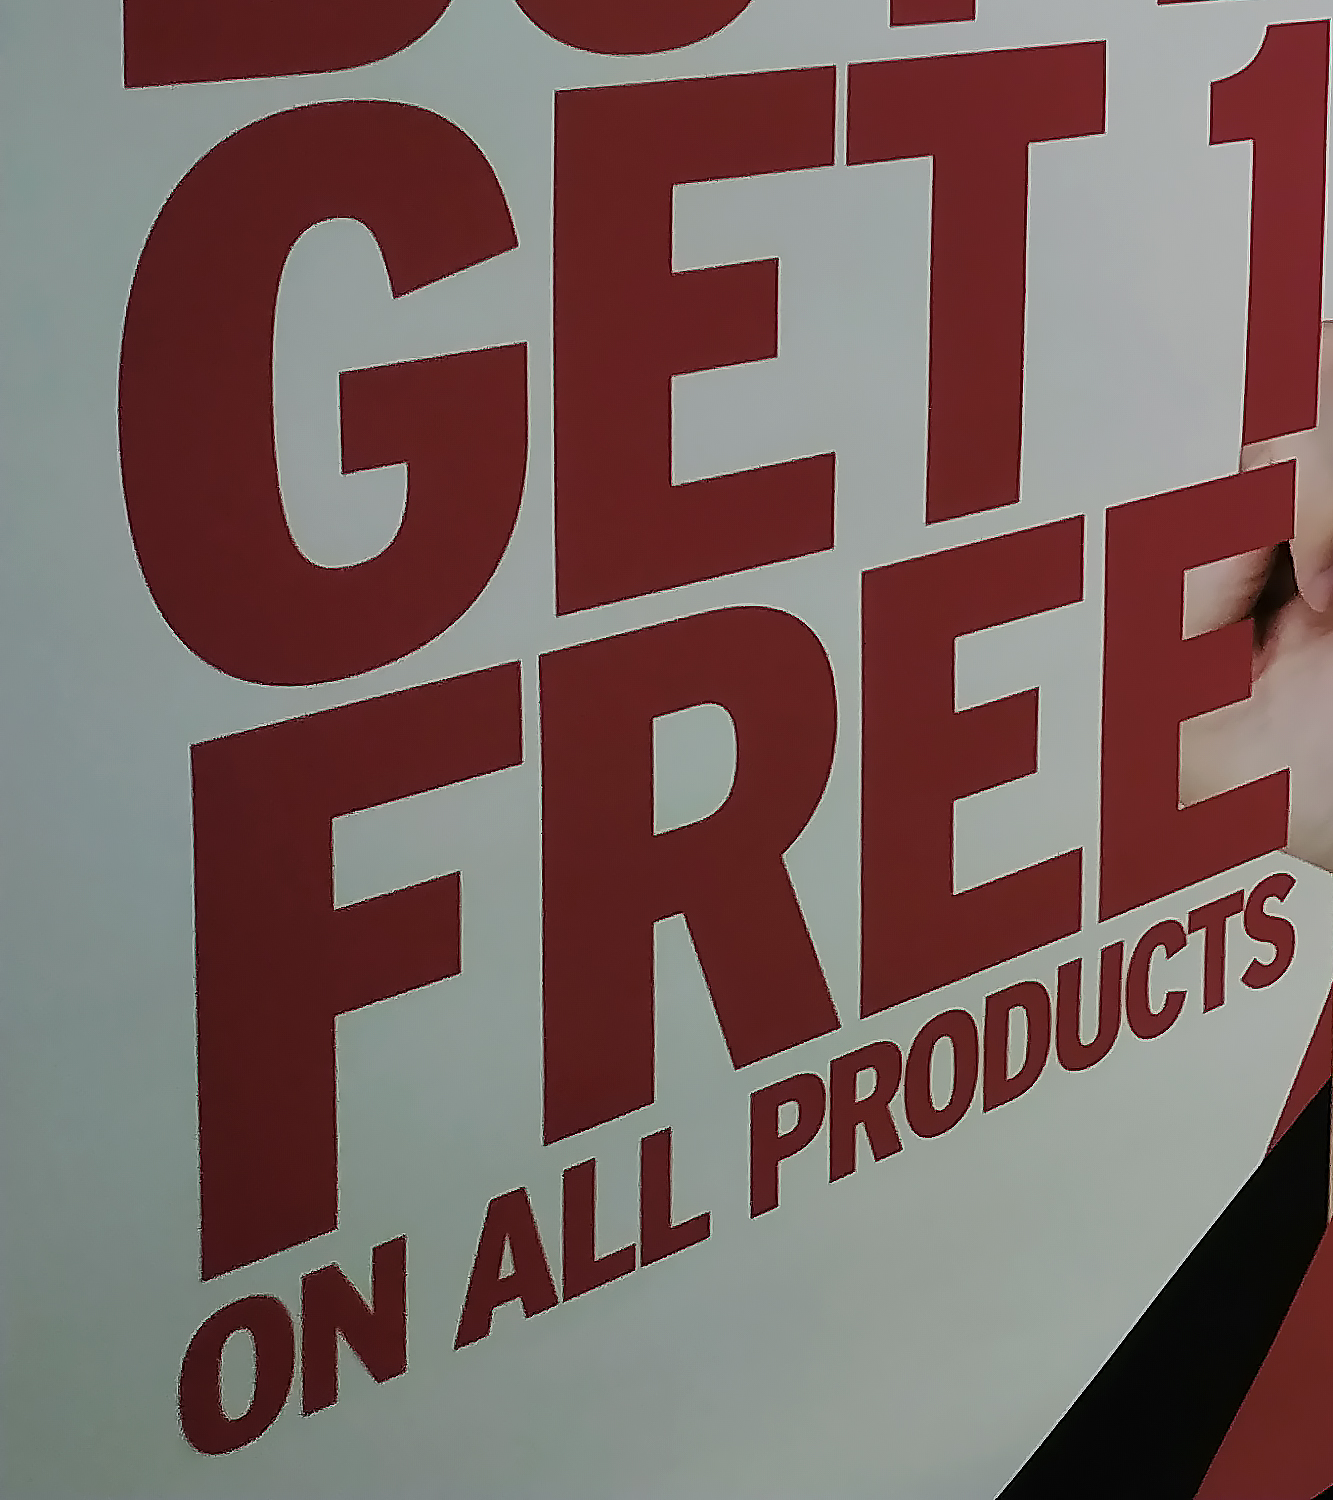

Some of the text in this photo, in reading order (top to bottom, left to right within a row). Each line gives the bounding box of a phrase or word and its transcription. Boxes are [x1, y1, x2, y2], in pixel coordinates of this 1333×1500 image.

[118, 19, 1332, 687] GET 1
[178, 872, 1298, 1457] ON ALL PRODUCTS
[190, 465, 1296, 1282] FREE
